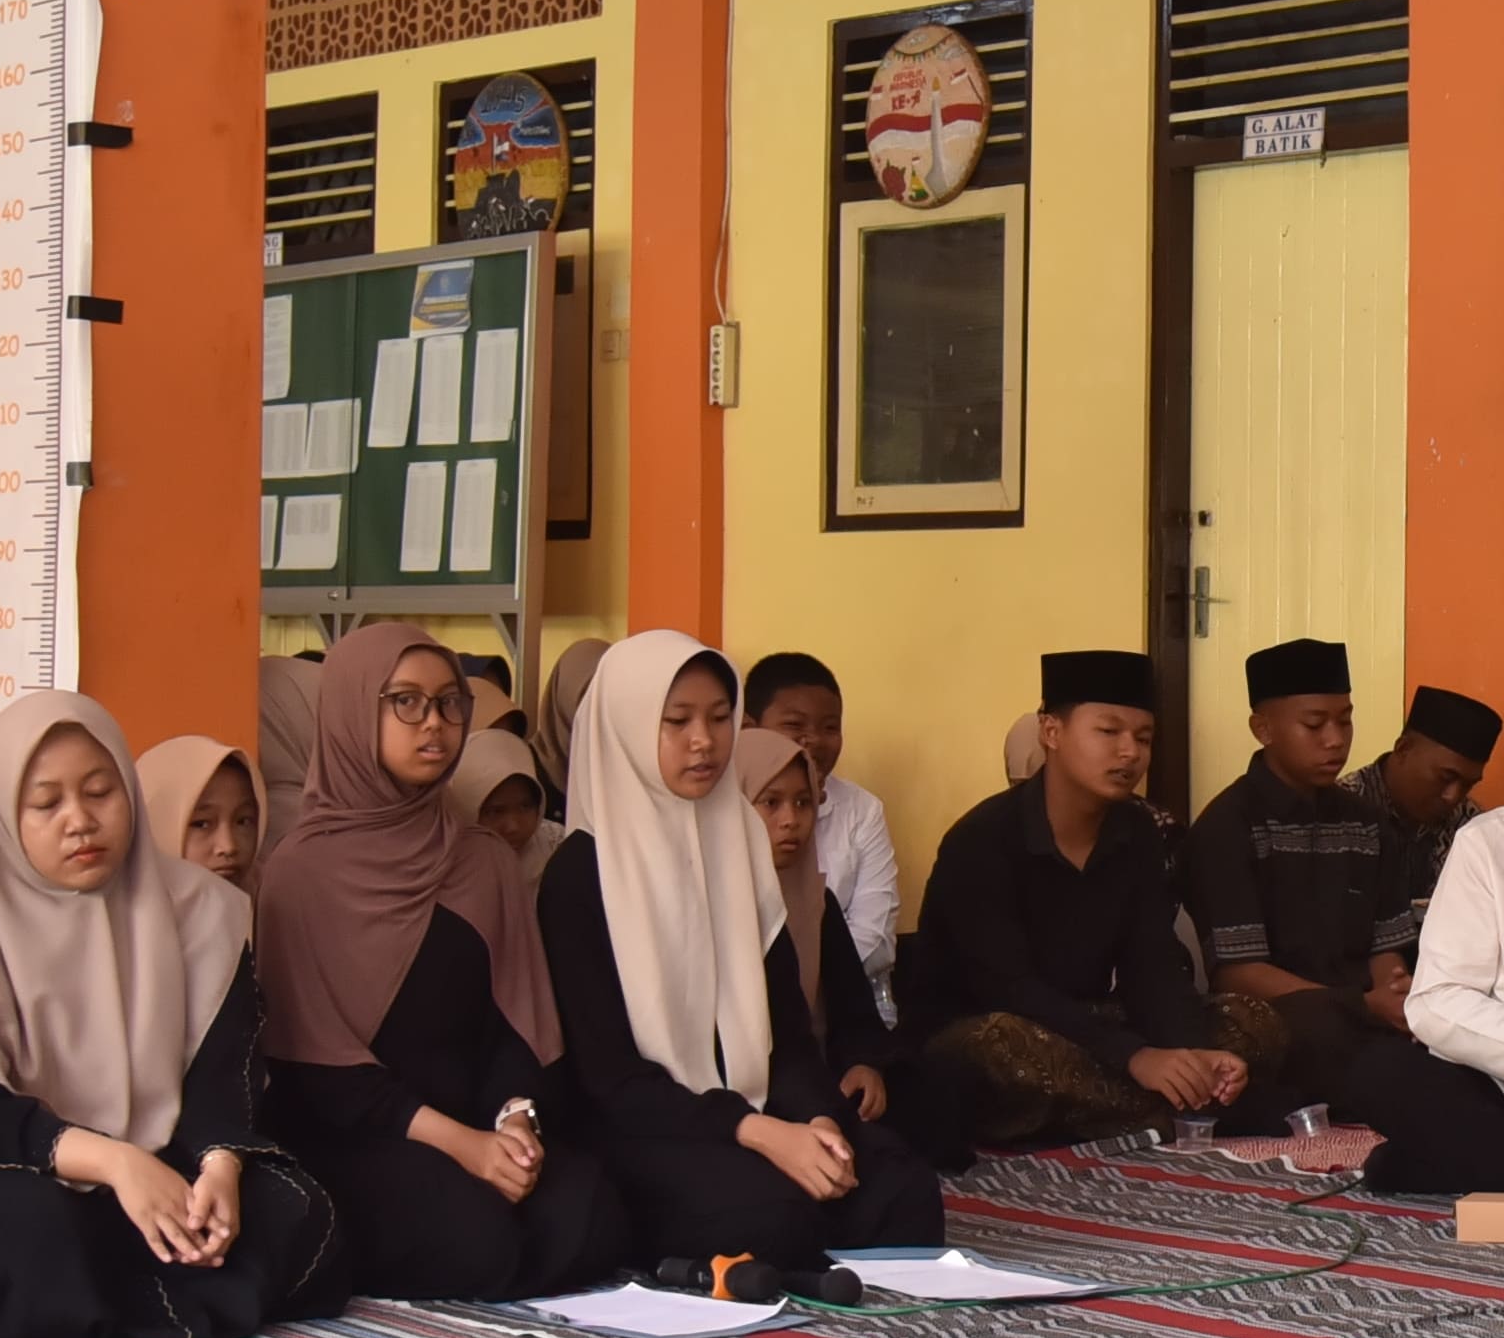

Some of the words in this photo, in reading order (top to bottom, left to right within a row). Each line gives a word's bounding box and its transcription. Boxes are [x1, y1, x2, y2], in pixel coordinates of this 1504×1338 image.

[1252, 119, 1268, 135] G.
[1272, 112, 1318, 133] ALAT
[1255, 133, 1312, 155] BATIK
